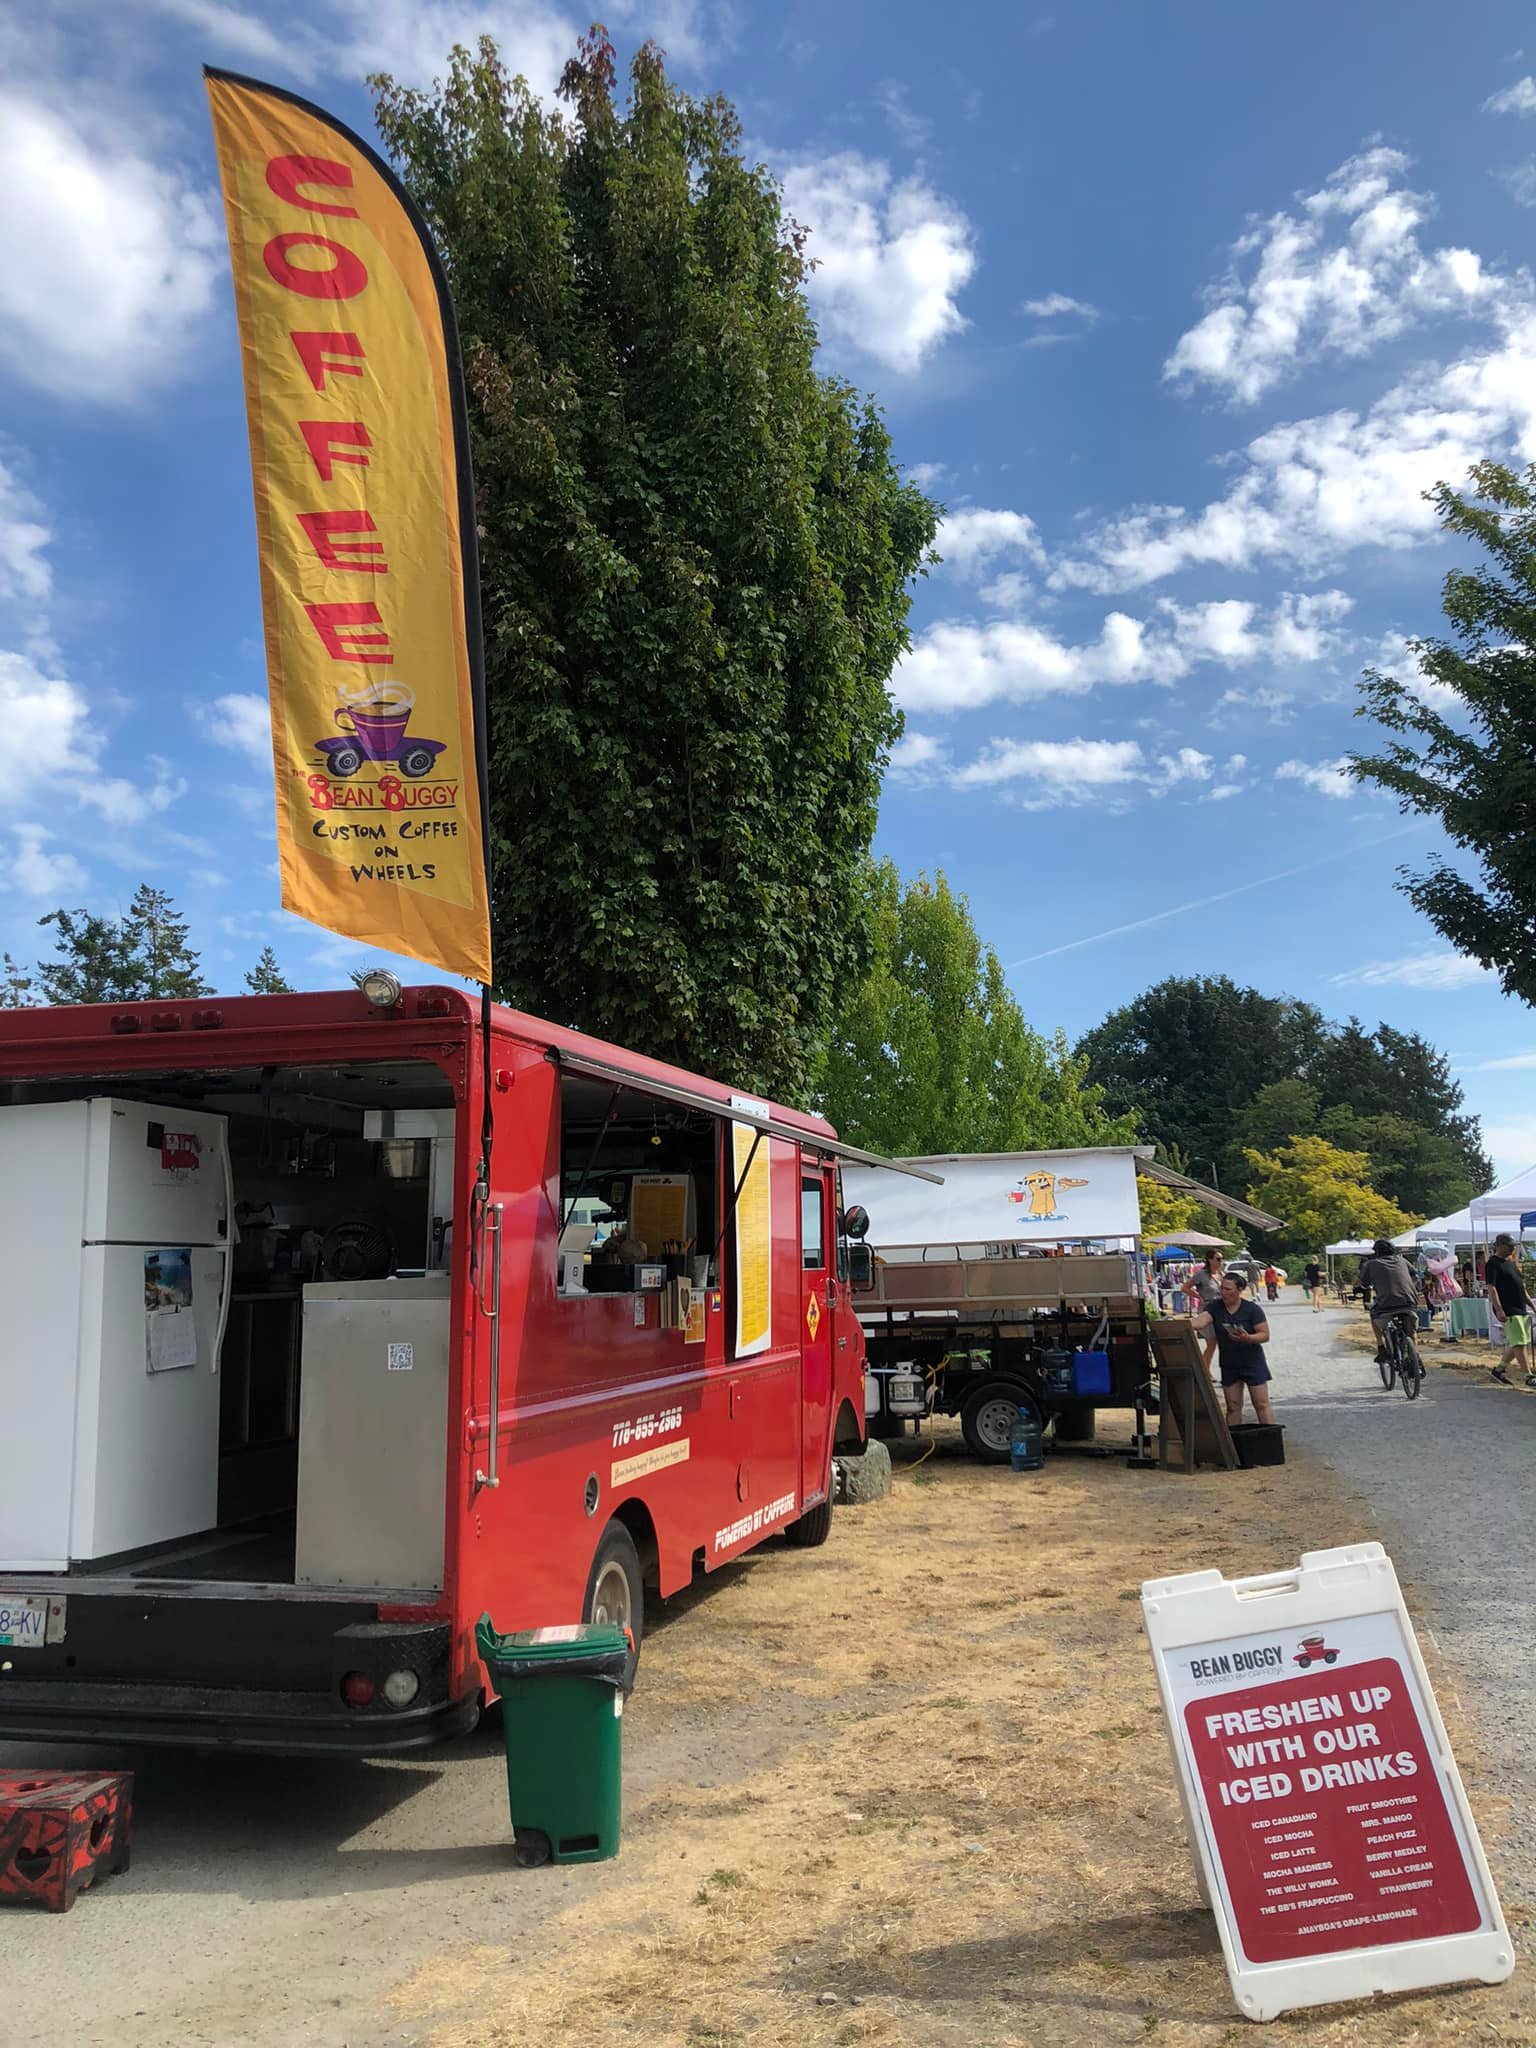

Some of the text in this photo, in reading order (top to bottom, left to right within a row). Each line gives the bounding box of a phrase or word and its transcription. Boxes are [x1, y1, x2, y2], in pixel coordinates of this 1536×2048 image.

[263, 154, 394, 664] COFFEE
[308, 774, 373, 811] BEAN
[378, 775, 458, 811] BUGGY
[312, 819, 457, 840] CUSTOM COFFEE
[350, 864, 436, 882] WHEELS
[1190, 1646, 1283, 1679] BEAN BUGGY
[1205, 1686, 1391, 1739] FRESHEN UP
[1227, 1723, 1380, 1769] WITH OUR
[1218, 1751, 1418, 1806] ICED DRINKS
[1346, 1795, 1418, 1813] FRUIT SMOOTHIES
[1251, 1812, 1318, 1829] ICED CANADIANO
[1361, 1813, 1413, 1828] MRS. MANGO
[1264, 1830, 1314, 1844] ICED MOCHA
[1367, 1829, 1417, 1844] PEACH FUZZ
[1270, 1846, 1316, 1860] ICED LATTE
[1366, 1845, 1427, 1862] BERRY MEDLEY
[1263, 1861, 1333, 1879] MOCHA MADNESS
[1369, 1861, 1434, 1879] VANILLA CREAM
[1266, 1878, 1339, 1896] THE WILLY WONKA
[1379, 1879, 1433, 1895] STRAWBERRY
[1260, 1905, 1277, 1915] THE
[1297, 1893, 1354, 1908] FRAPPUCCINO
